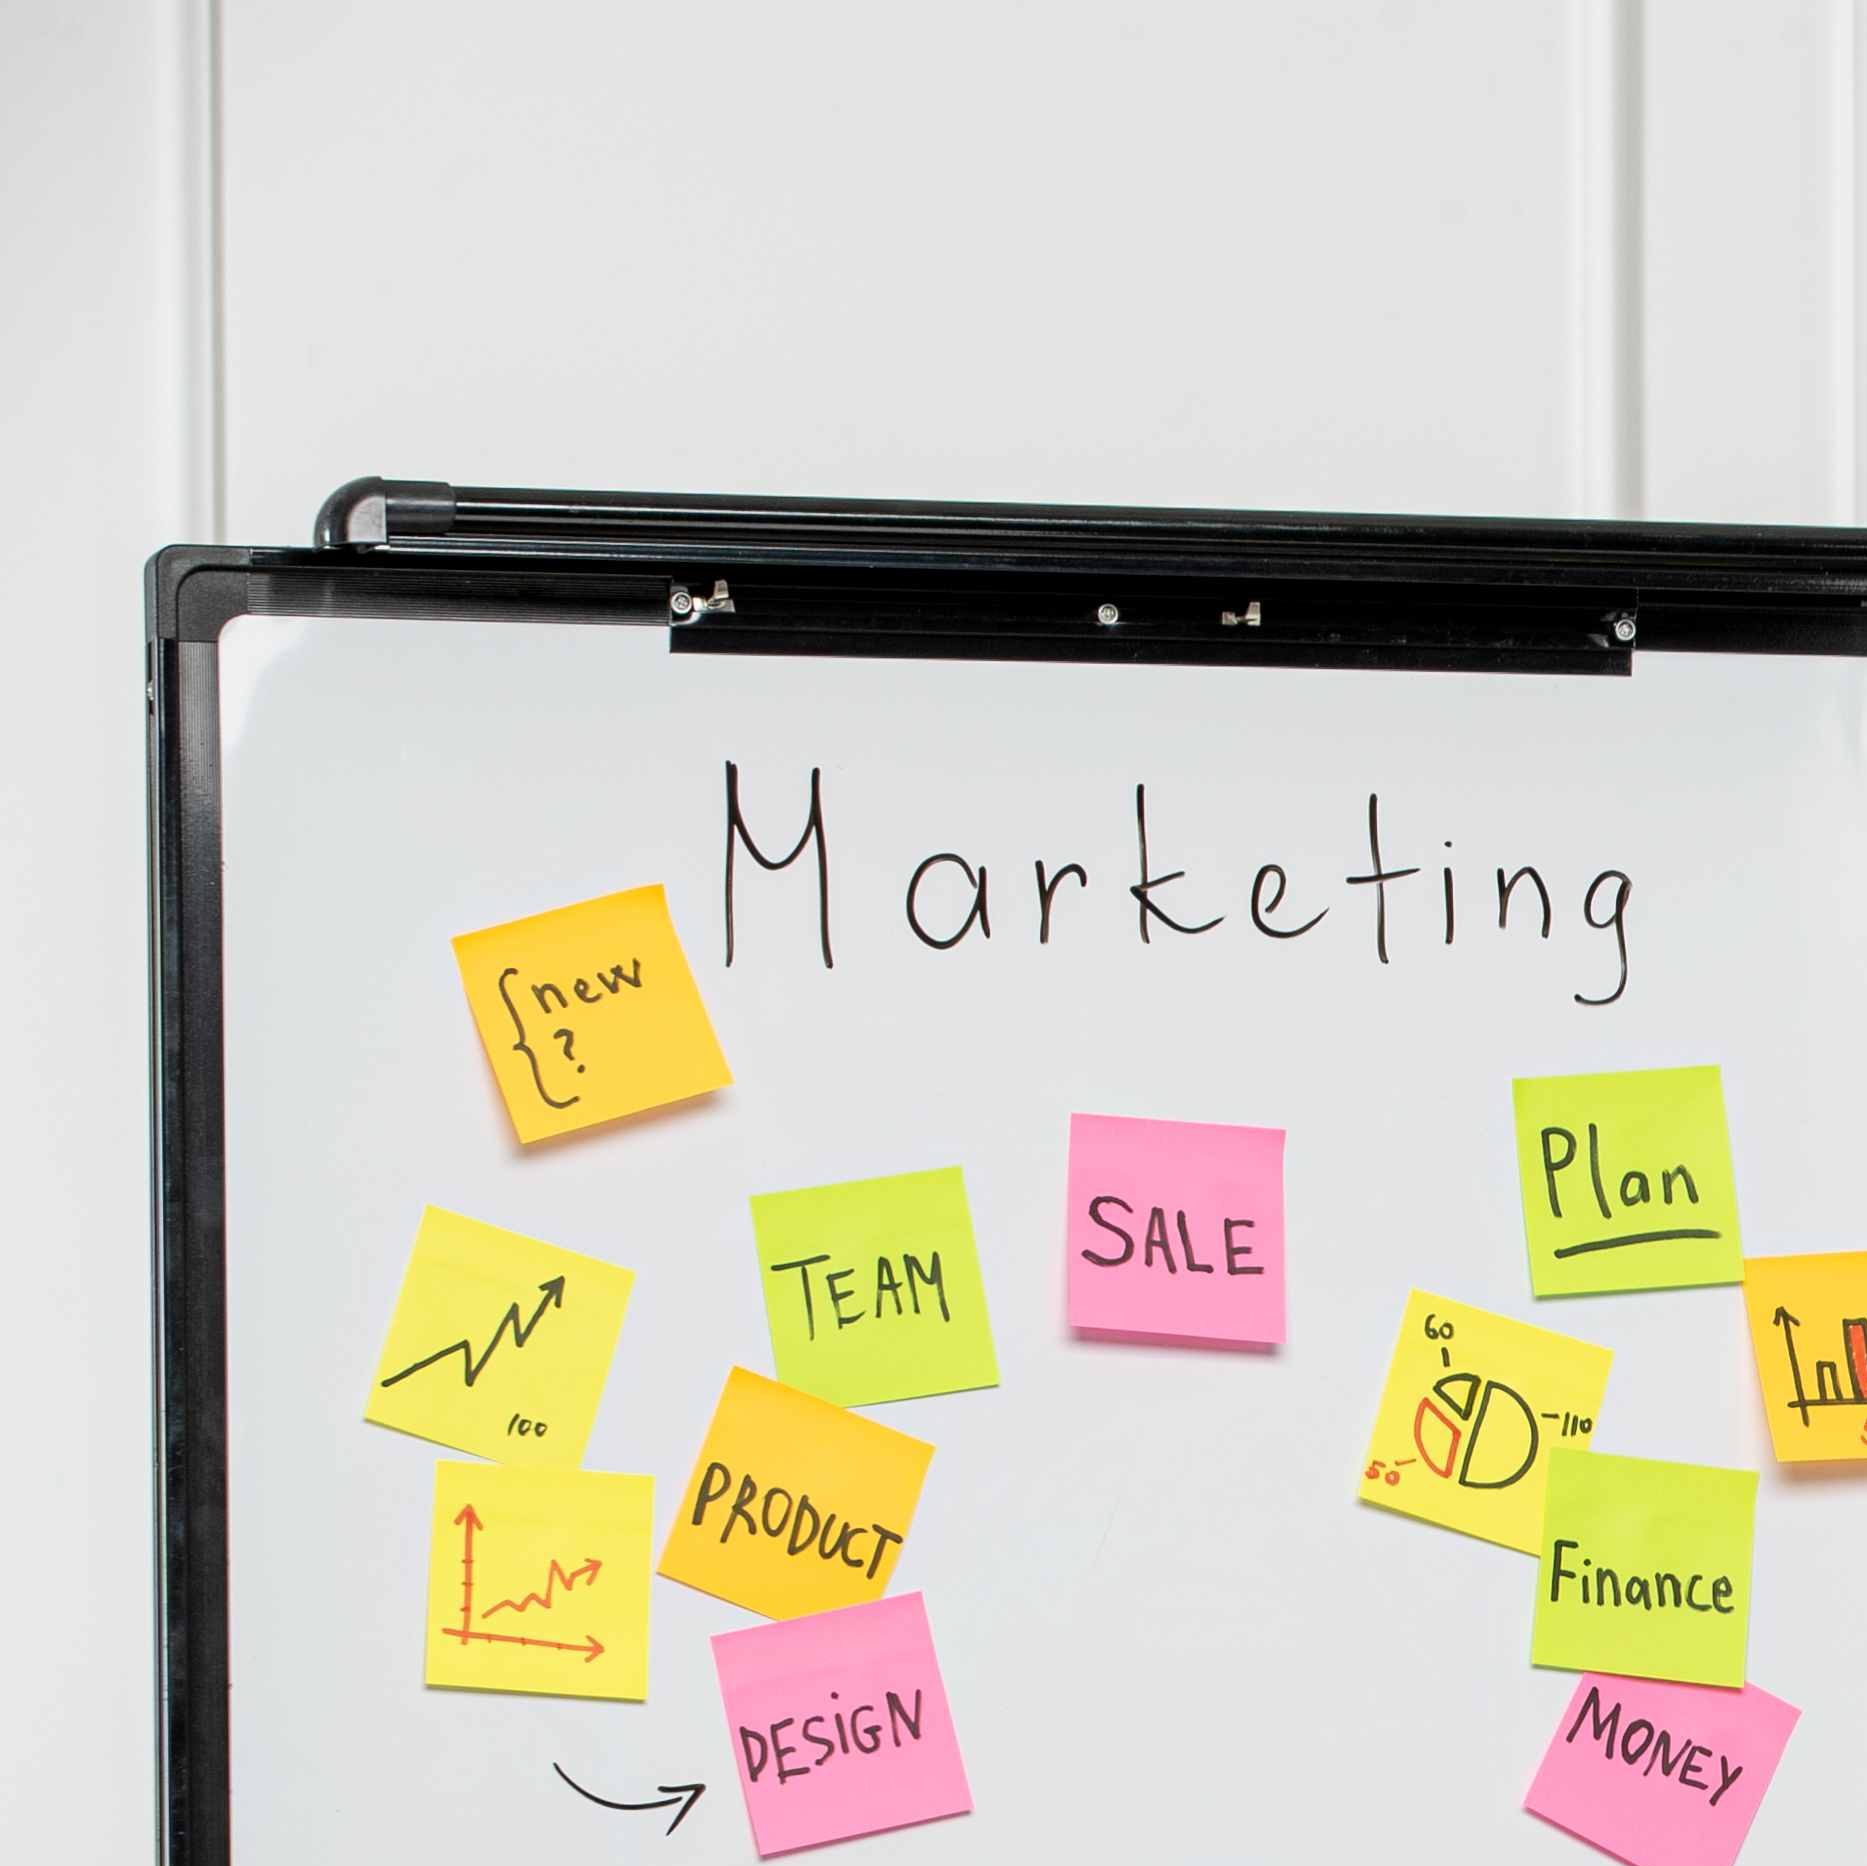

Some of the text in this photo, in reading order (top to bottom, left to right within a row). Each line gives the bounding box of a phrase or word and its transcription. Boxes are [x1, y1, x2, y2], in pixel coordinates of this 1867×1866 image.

[724, 760, 1632, 1006] Marketing
[1539, 1122, 1700, 1220] Plan
[1080, 1196, 1266, 1278] SALE
[771, 1250, 950, 1341] TEAM
[1424, 1313, 1455, 1340] 60
[506, 1412, 548, 1439] 100
[1365, 1460, 1401, 1487] 50
[691, 1461, 905, 1580] PRODUCT
[1550, 1539, 1735, 1615] Finance
[739, 1689, 924, 1786] DESIGN
[1565, 1686, 1744, 1808] MONEY
